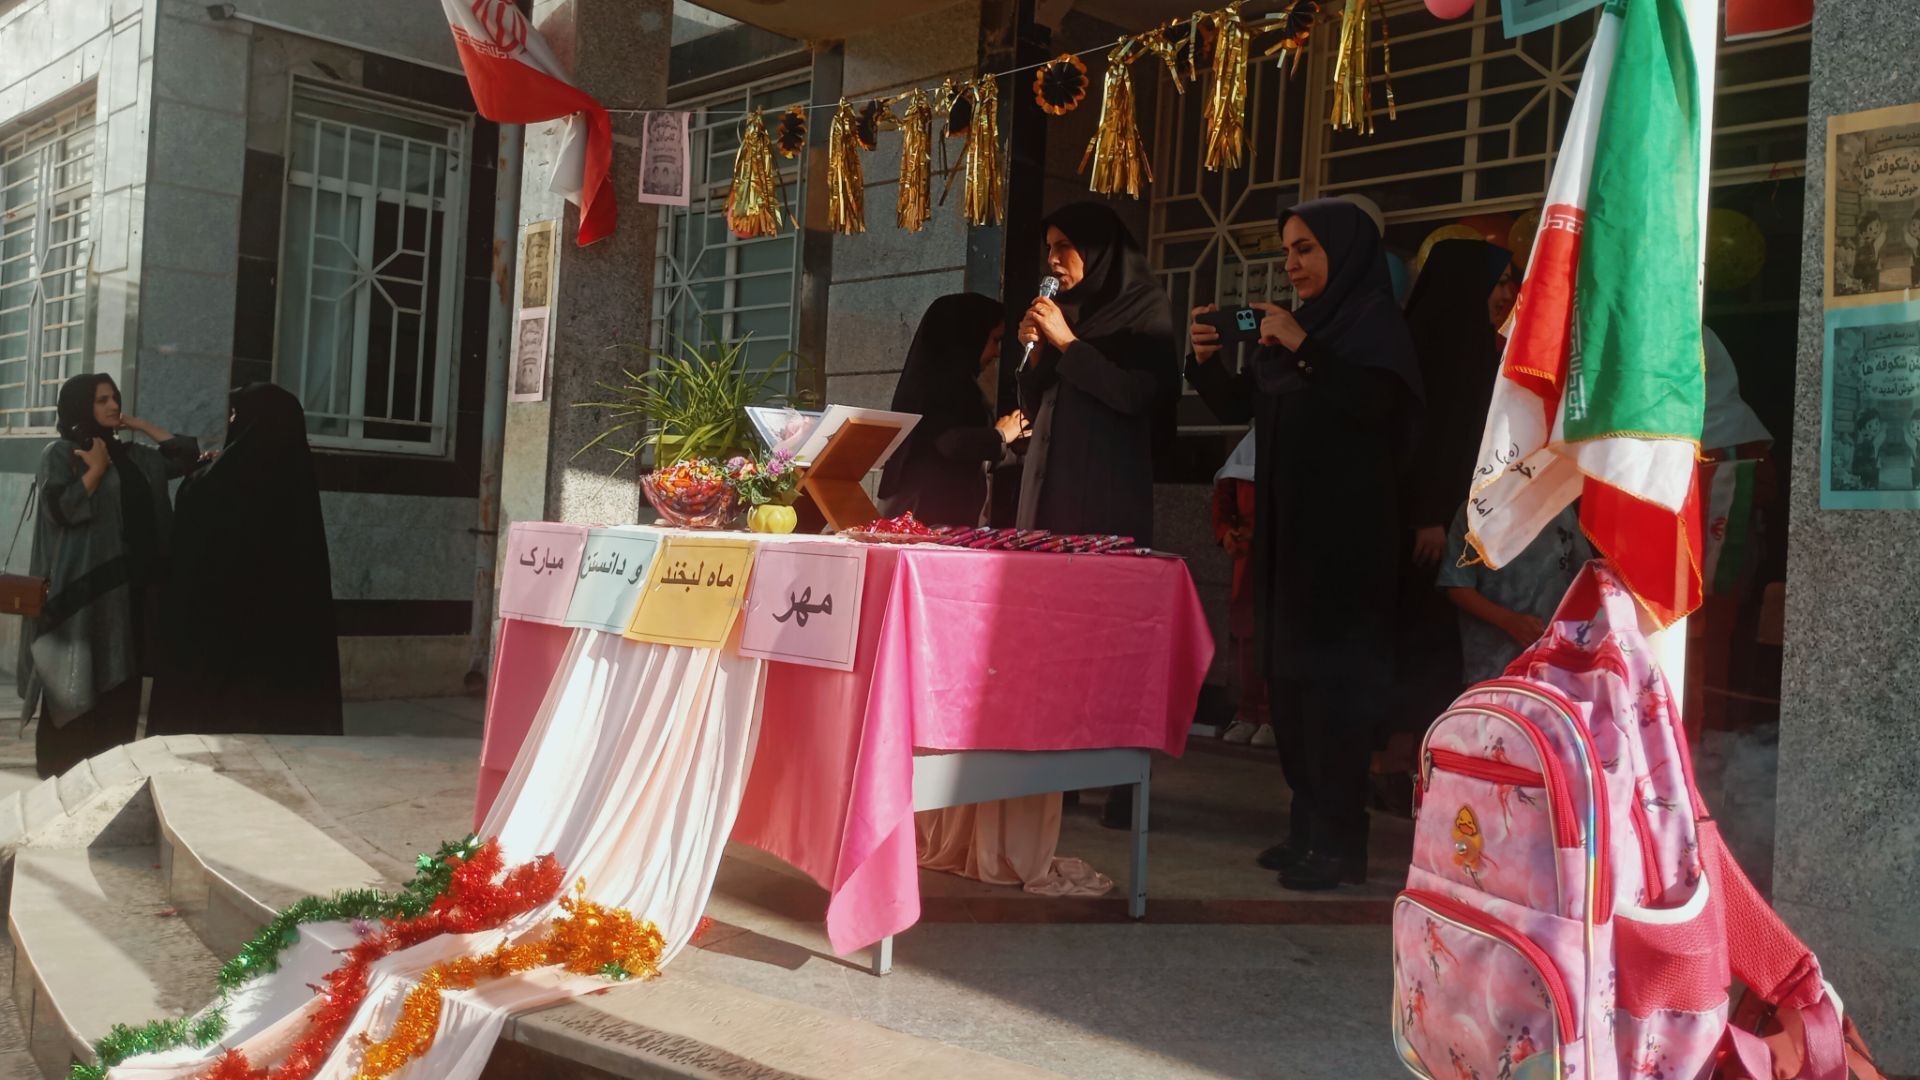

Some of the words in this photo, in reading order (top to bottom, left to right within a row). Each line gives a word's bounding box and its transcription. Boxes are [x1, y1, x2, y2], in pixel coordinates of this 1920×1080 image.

[519, 546, 564, 576] مبارک
[580, 551, 627, 579] دانستن
[627, 564, 643, 585] و
[706, 563, 734, 588] ماه
[660, 560, 704, 593] لبخند
[772, 586, 833, 627] مهر
